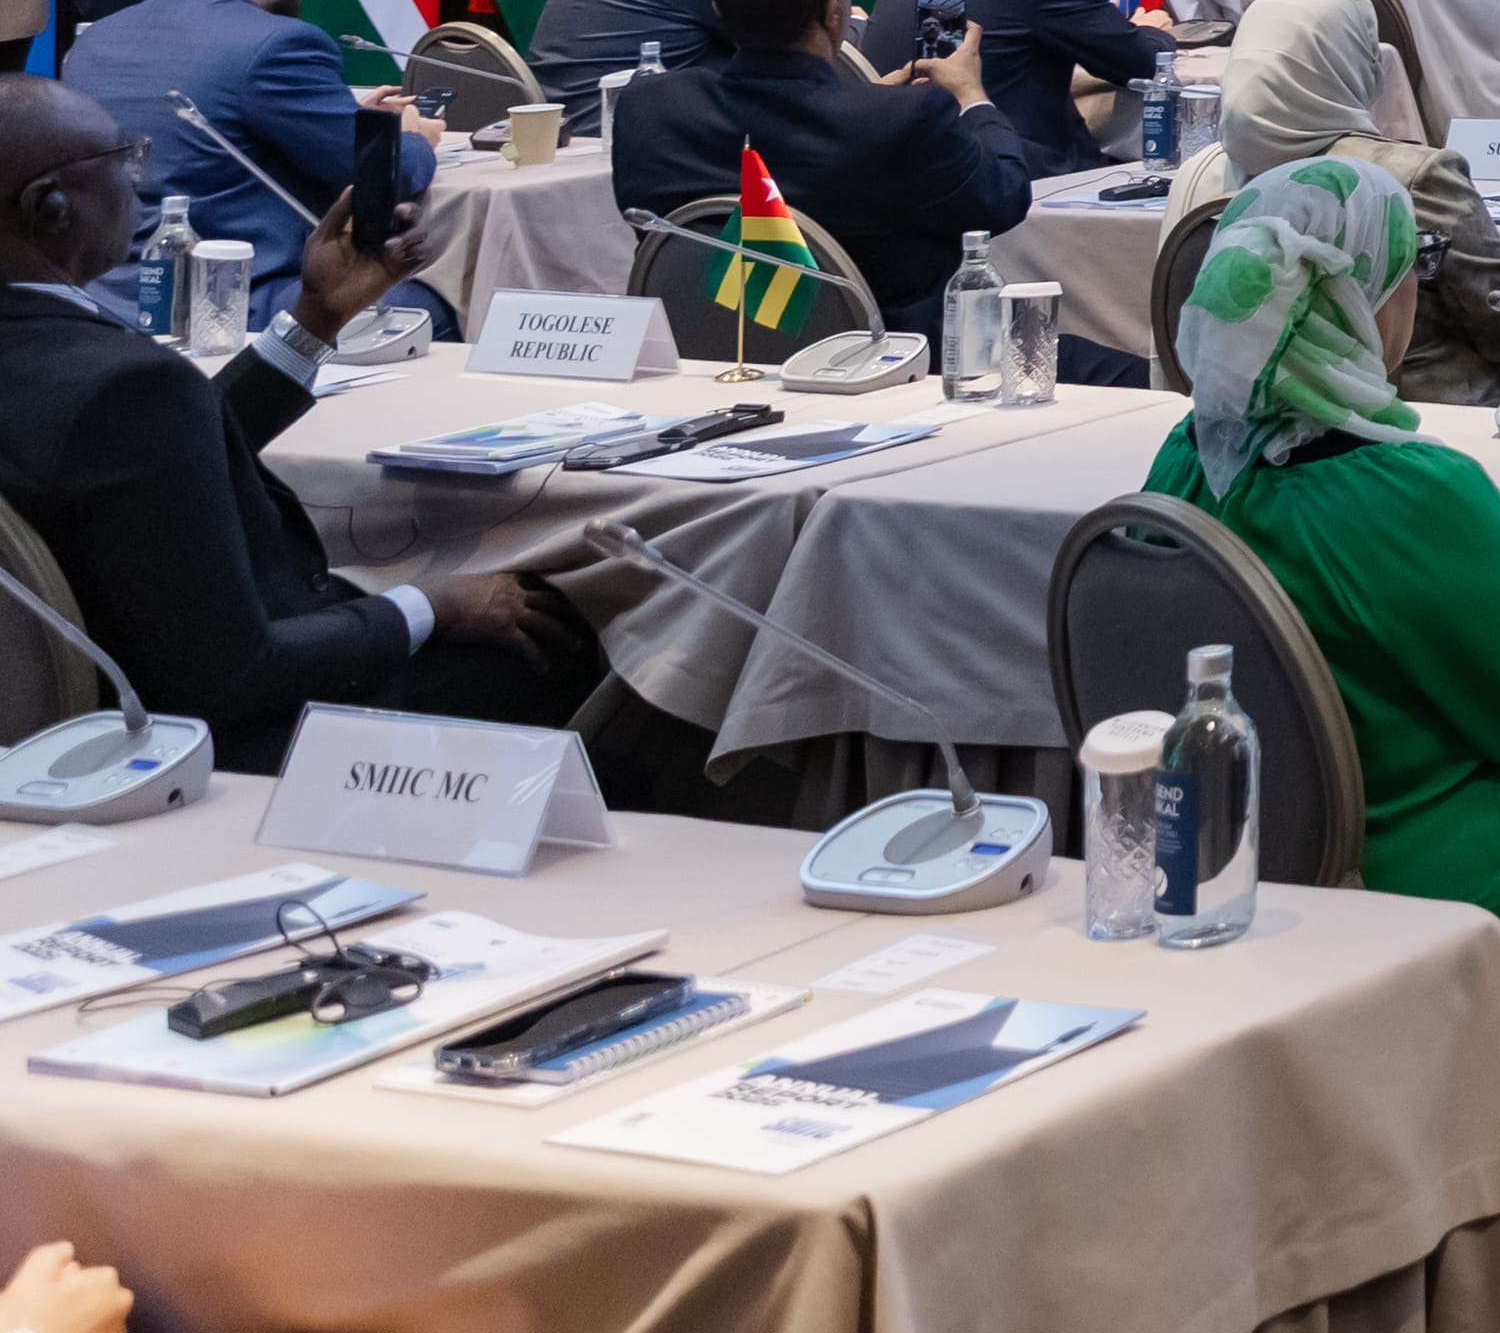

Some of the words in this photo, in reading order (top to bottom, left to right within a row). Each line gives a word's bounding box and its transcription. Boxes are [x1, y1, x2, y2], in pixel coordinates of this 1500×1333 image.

[518, 312, 615, 335] TOGOLESE
[510, 340, 603, 362] REPUBLIC
[344, 760, 434, 798] SMIIC
[435, 769, 489, 803] MC
